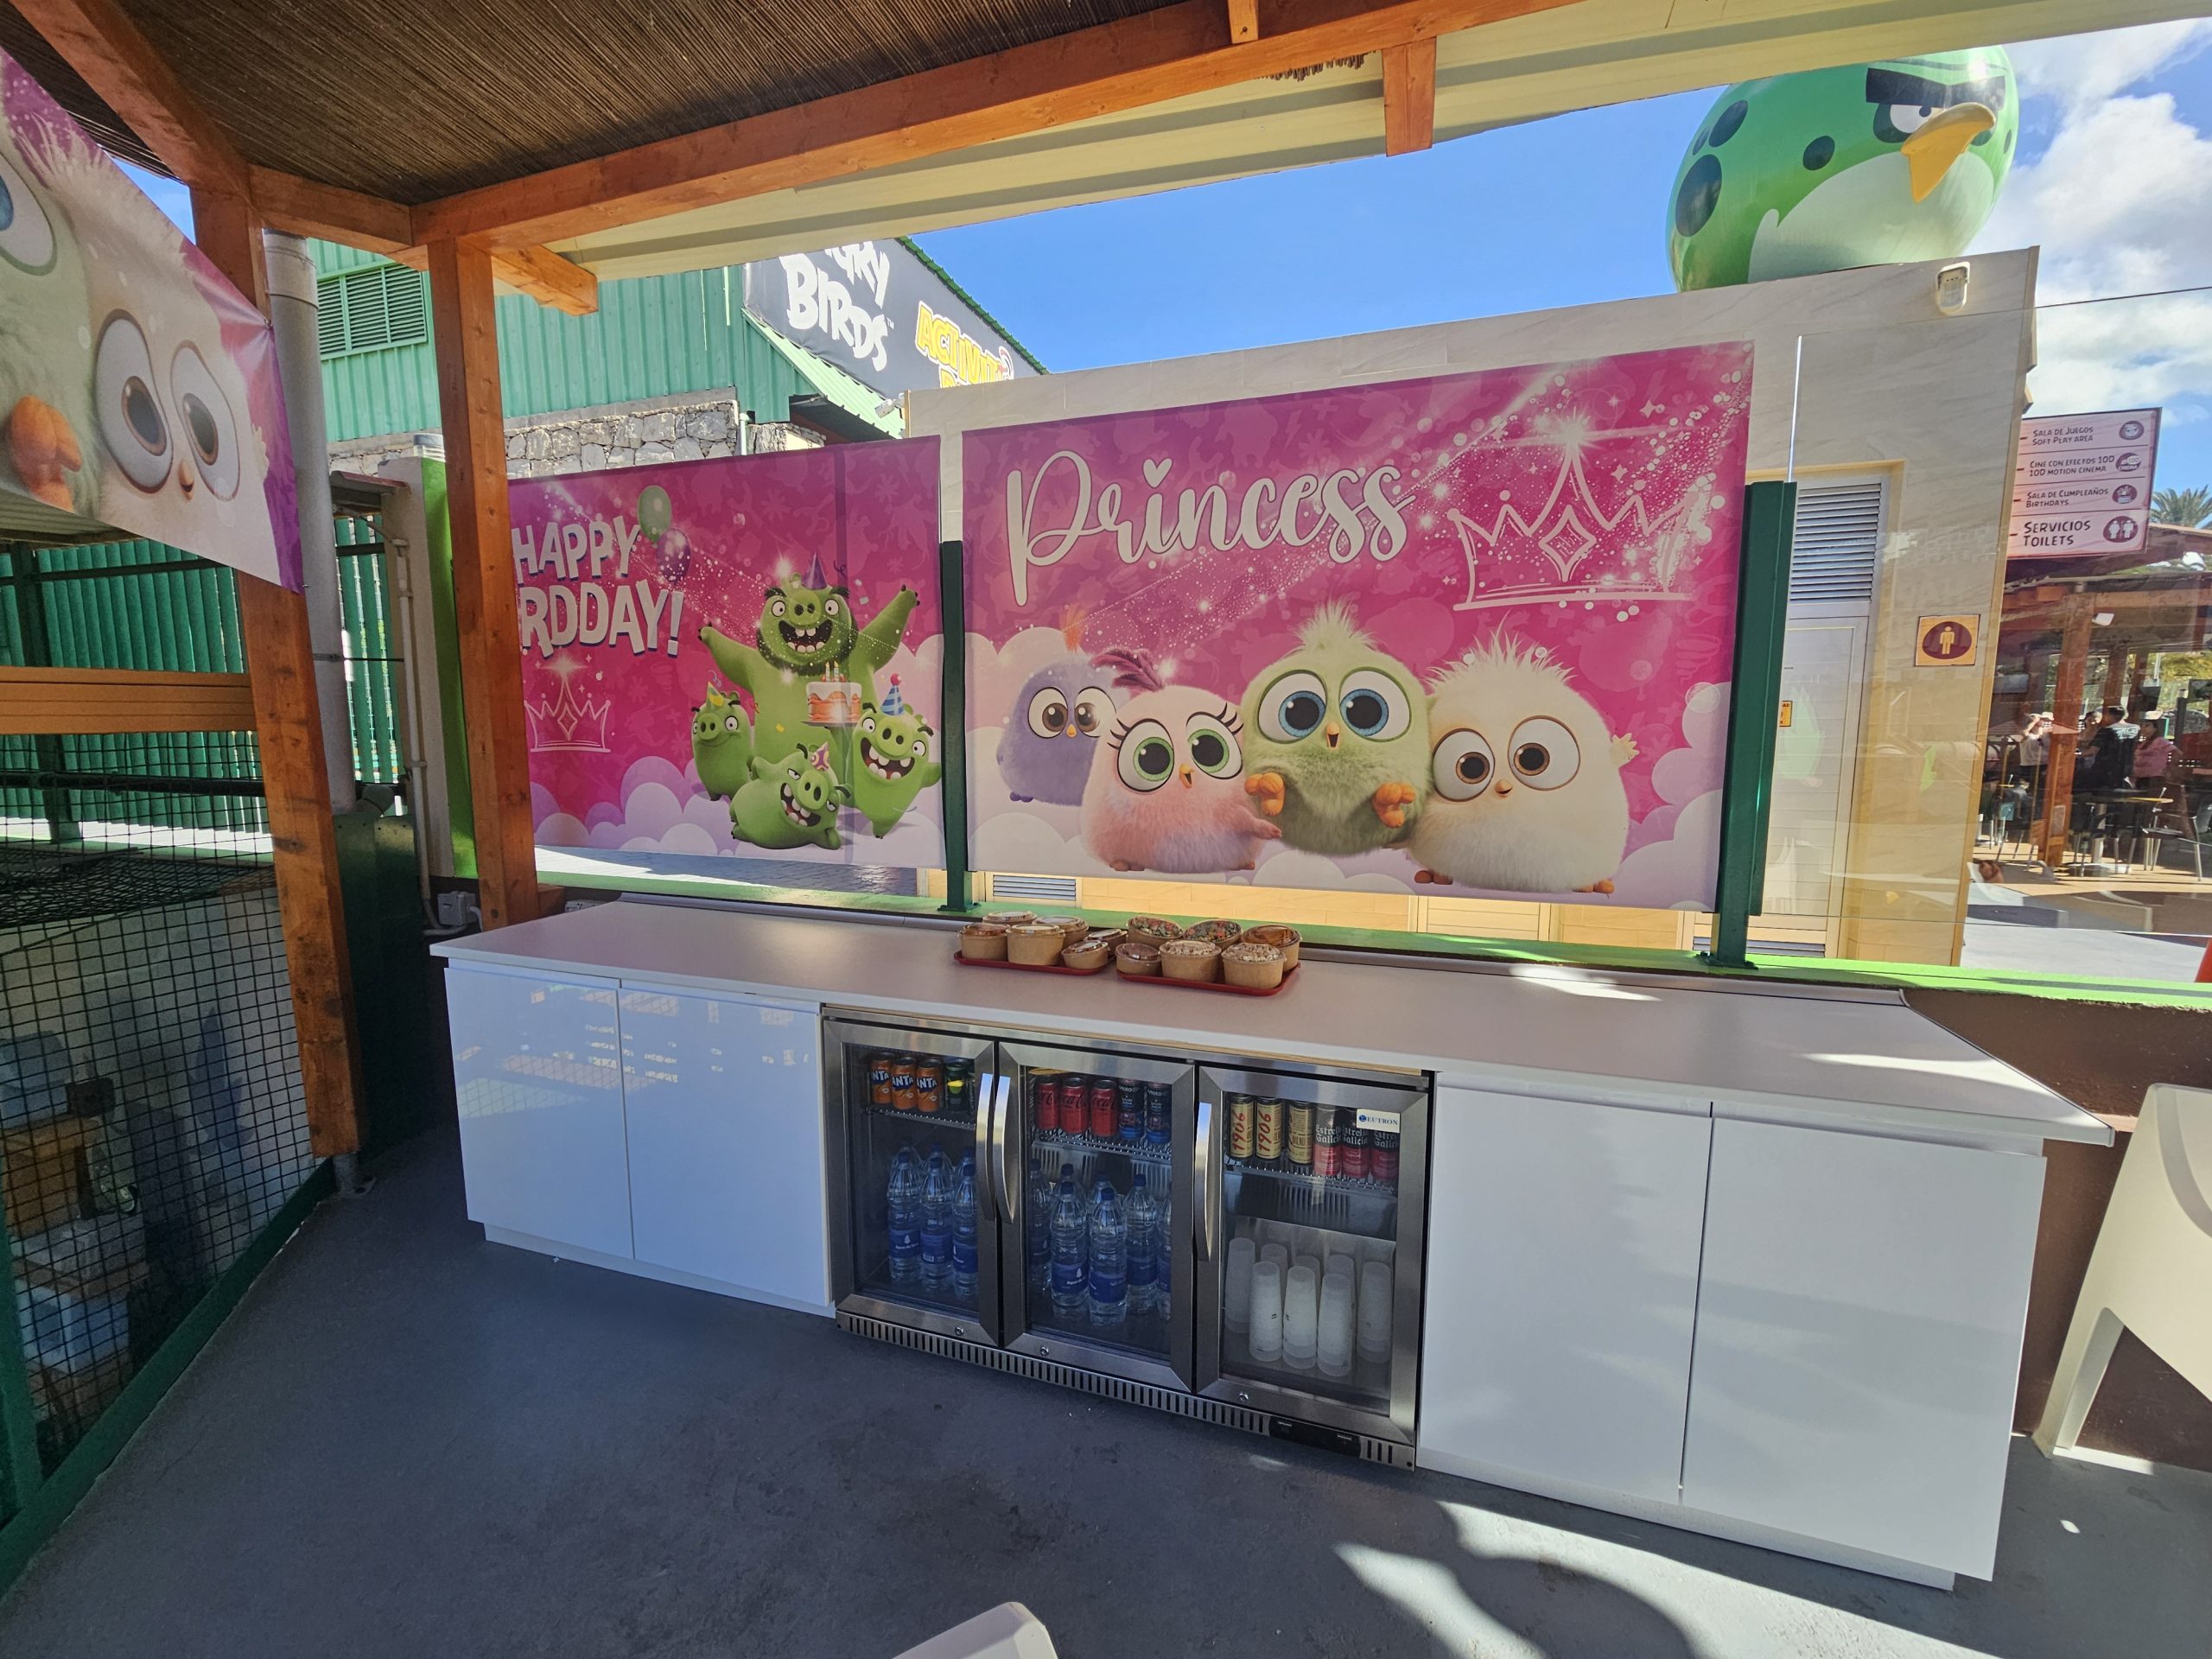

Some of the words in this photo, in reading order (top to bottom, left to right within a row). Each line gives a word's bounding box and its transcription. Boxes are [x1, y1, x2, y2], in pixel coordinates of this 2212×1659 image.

[779, 253, 888, 372] BIRDS
[915, 301, 1004, 385] ACTIVIT
[2032, 437, 2050, 446] SOFT
[511, 516, 640, 586] HAPPY
[1007, 450, 1415, 606] Princess
[2023, 534, 2074, 547] TOILETS
[2024, 519, 2091, 534] SERVICIOS
[519, 579, 685, 658] RDDAY!
[1257, 1109, 1272, 1151] 1906
